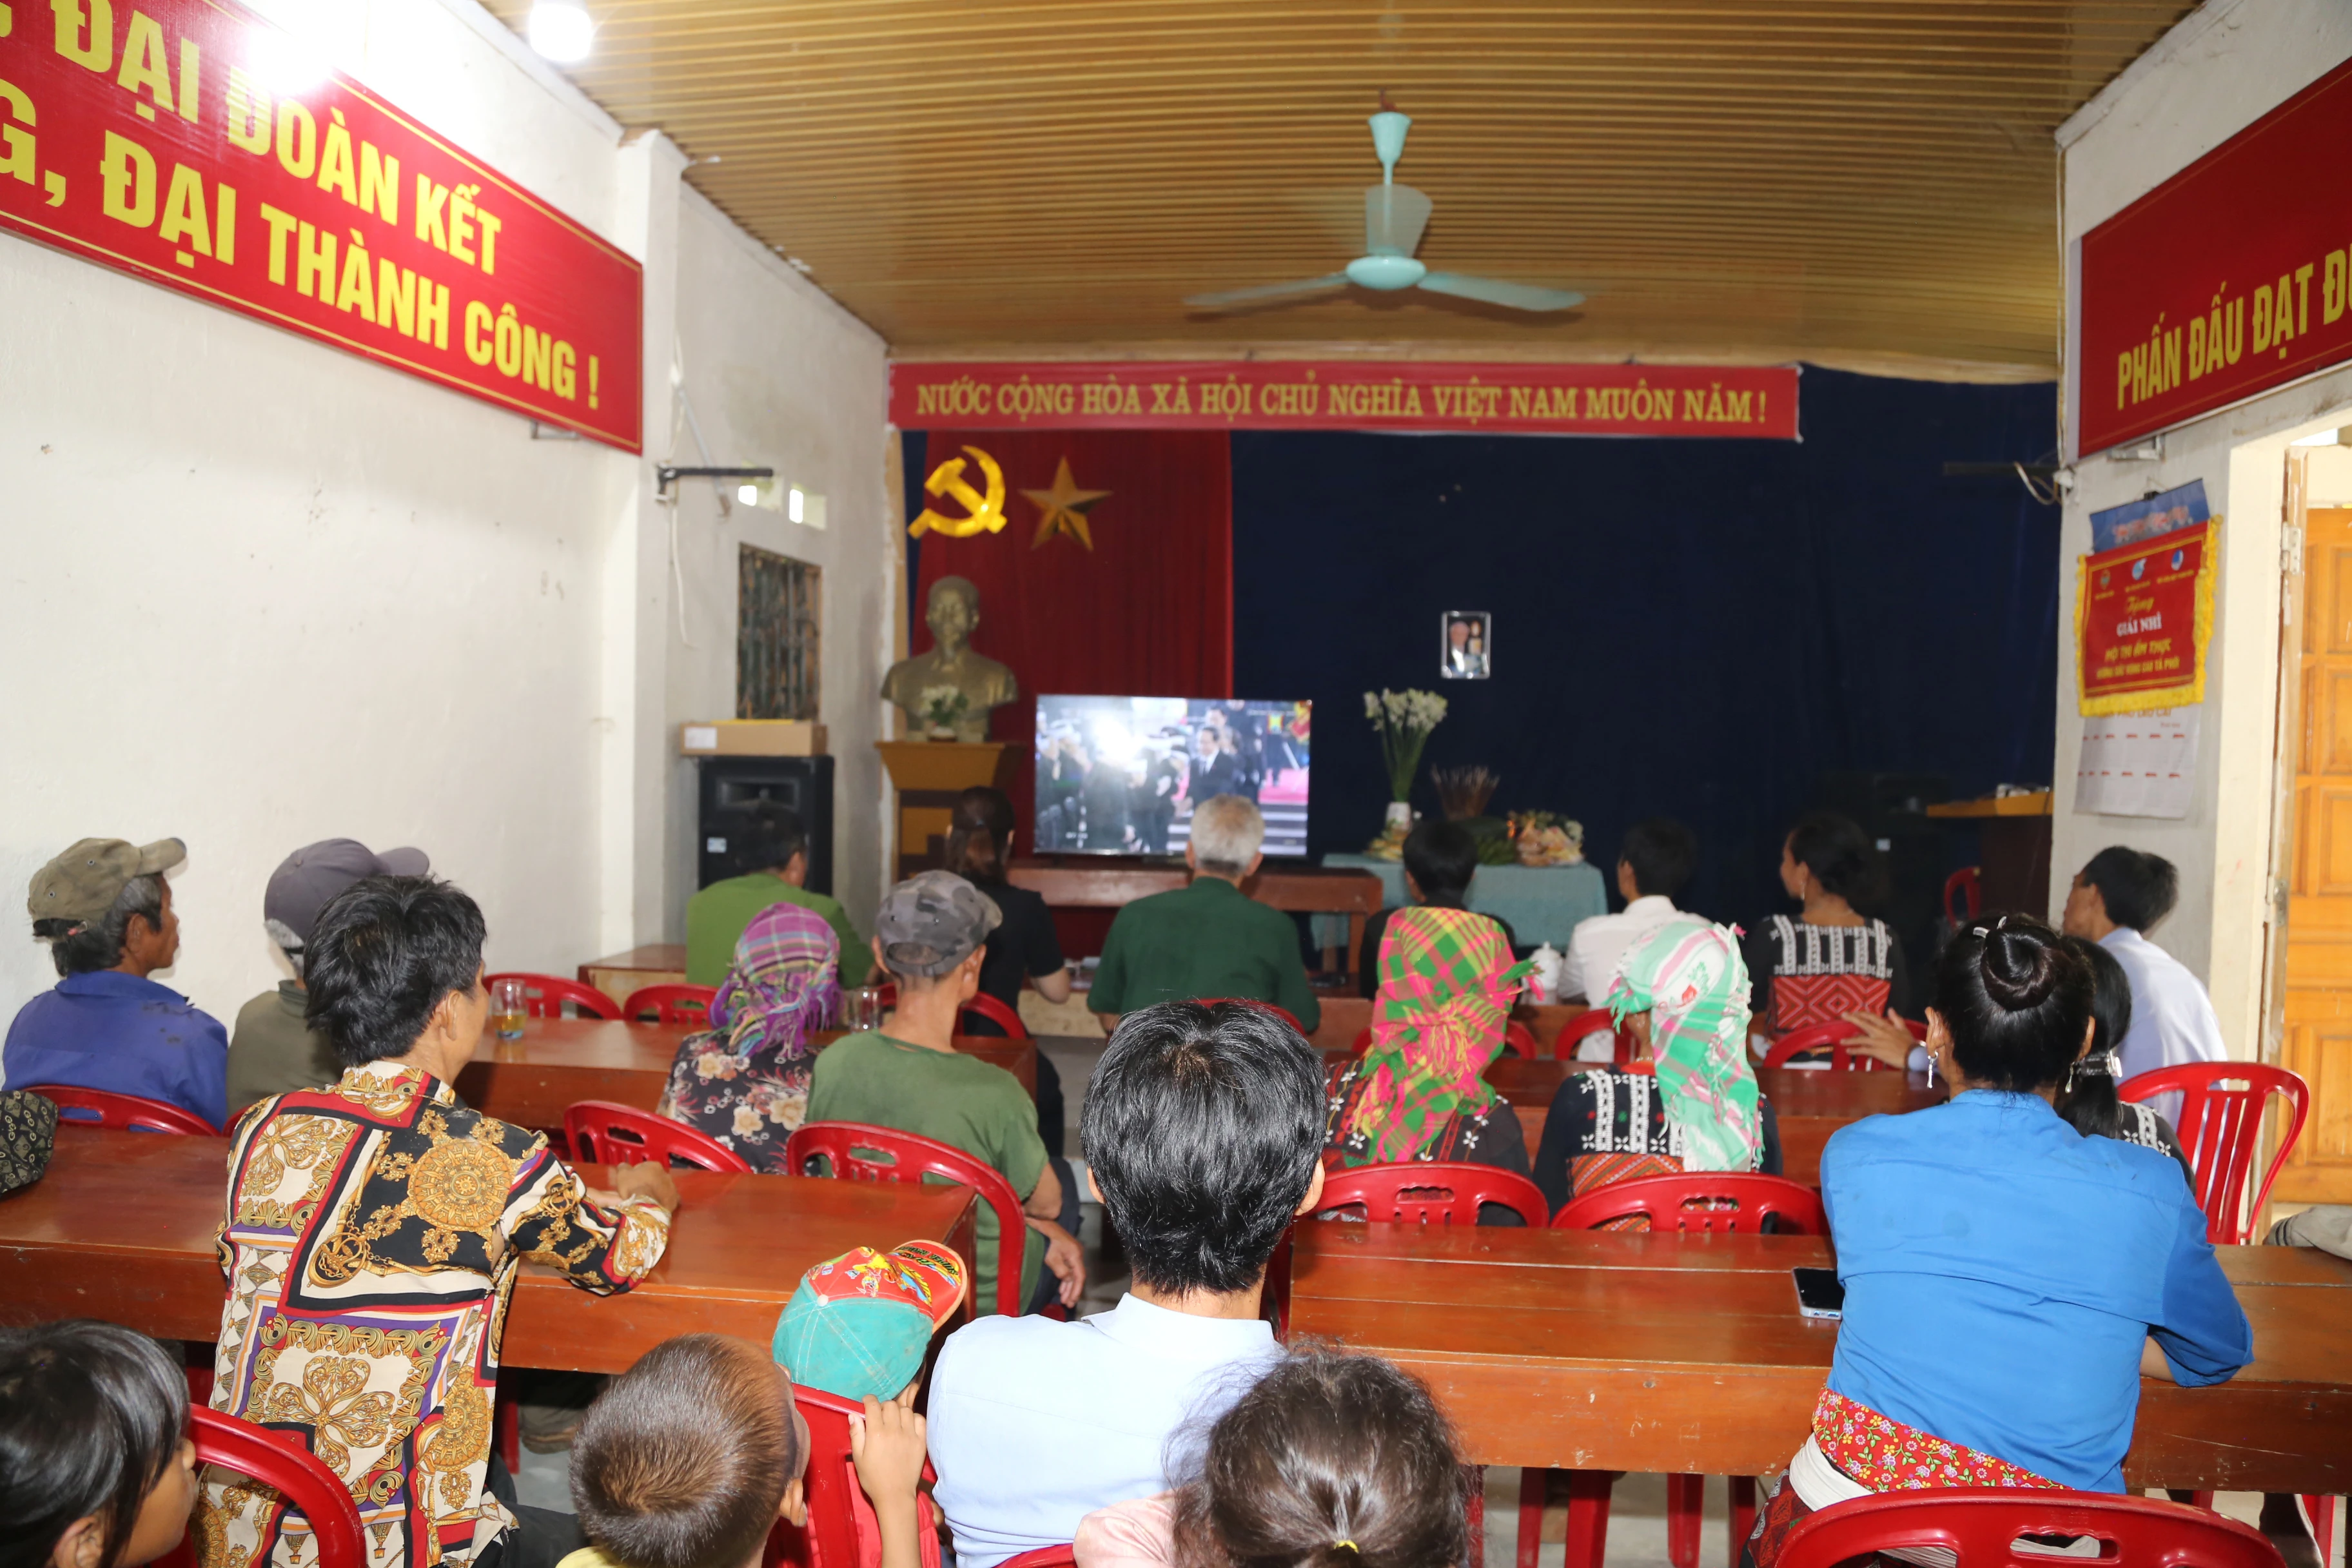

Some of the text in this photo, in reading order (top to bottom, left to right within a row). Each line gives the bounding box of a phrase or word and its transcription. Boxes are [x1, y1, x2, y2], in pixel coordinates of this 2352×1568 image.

[50, 0, 502, 275] ĐẠI ĐOÀN KẾT
[100, 130, 236, 268] ĐẠI
[260, 202, 449, 351] THÀNH
[464, 302, 576, 402] CÔNG
[2118, 244, 2352, 410] PHẤN ĐẤU ĐẠT Đ
[916, 374, 992, 415] NƯỚC
[997, 374, 1075, 423] CỘNG
[1081, 374, 1142, 415] HÒA
[1151, 376, 1191, 415] XÃ
[1199, 373, 1253, 423] HỘI
[1259, 369, 1320, 415] CHỦ
[1328, 377, 1423, 418] NGHĨA
[1433, 376, 1502, 426] VIỆT
[1509, 386, 1578, 419] NAM
[1585, 378, 1676, 421] MUÔN
